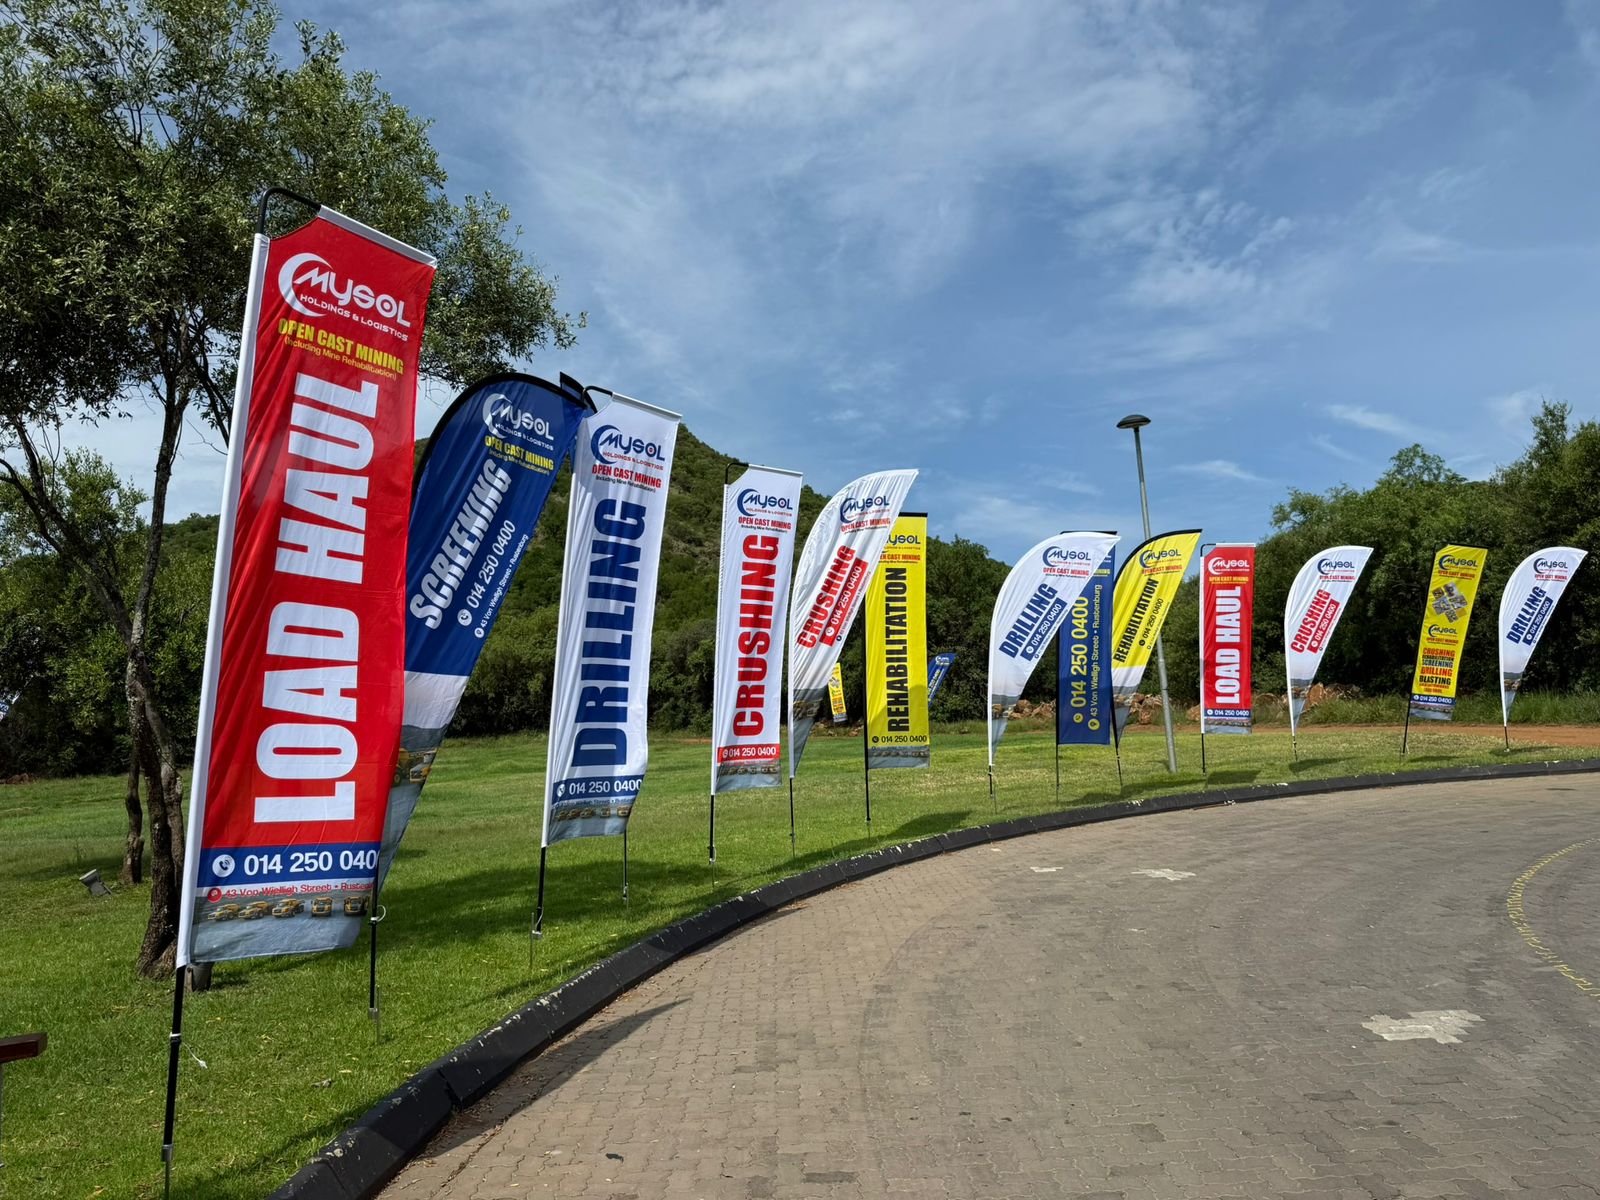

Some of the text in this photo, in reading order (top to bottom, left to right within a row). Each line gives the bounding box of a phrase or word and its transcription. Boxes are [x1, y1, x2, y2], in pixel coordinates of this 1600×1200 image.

[300, 294, 408, 341] HOLDINGS & LOGISTICS
[278, 318, 404, 374] OPEN CAST MINING
[285, 336, 397, 380] (Including Mine Rehabilitation)
[484, 435, 503, 452] OPEN
[504, 443, 525, 459] CAST
[526, 450, 554, 470] MINING
[592, 464, 662, 488] OPEN CAST MINING
[410, 458, 512, 630] SCREENING
[738, 516, 754, 524] OPEN
[754, 518, 770, 526] CAST
[771, 520, 792, 530] MINING
[466, 520, 516, 608] 014 250 0400
[254, 372, 379, 823] LOAD HAUL
[797, 545, 856, 648] CRUSHING
[830, 609, 842, 624] 014
[838, 590, 852, 608] 250
[846, 566, 862, 589] 0400
[998, 583, 1058, 658] DRILLING
[1113, 577, 1159, 663] REHABILITATION
[1142, 628, 1151, 638] 014
[1147, 614, 1156, 627] 250
[1153, 598, 1164, 614] 0400
[1216, 586, 1241, 642] HAUL
[1290, 588, 1331, 653] CRUSHING
[1506, 586, 1547, 644] DRILLING
[571, 498, 647, 768] DRILLING
[733, 534, 780, 736] CRUSHING
[885, 568, 910, 732] REHABILITATION
[1031, 604, 1062, 646] 014 250 0400
[1070, 596, 1089, 708] 014 250 0400
[1215, 648, 1240, 704] LOAD
[1421, 666, 1452, 677] DRILLING
[1423, 648, 1455, 657] CRUSHING
[1090, 691, 1098, 706] Von
[1419, 675, 1451, 685] BLASTING
[1090, 708, 1098, 716] 43
[729, 746, 776, 758] 014 250 0400
[569, 779, 642, 795] 014 250 0400
[244, 850, 380, 876] 014 250 040
[226, 889, 238, 898] 43
[240, 888, 260, 897] Von
[300, 884, 332, 893] Street
